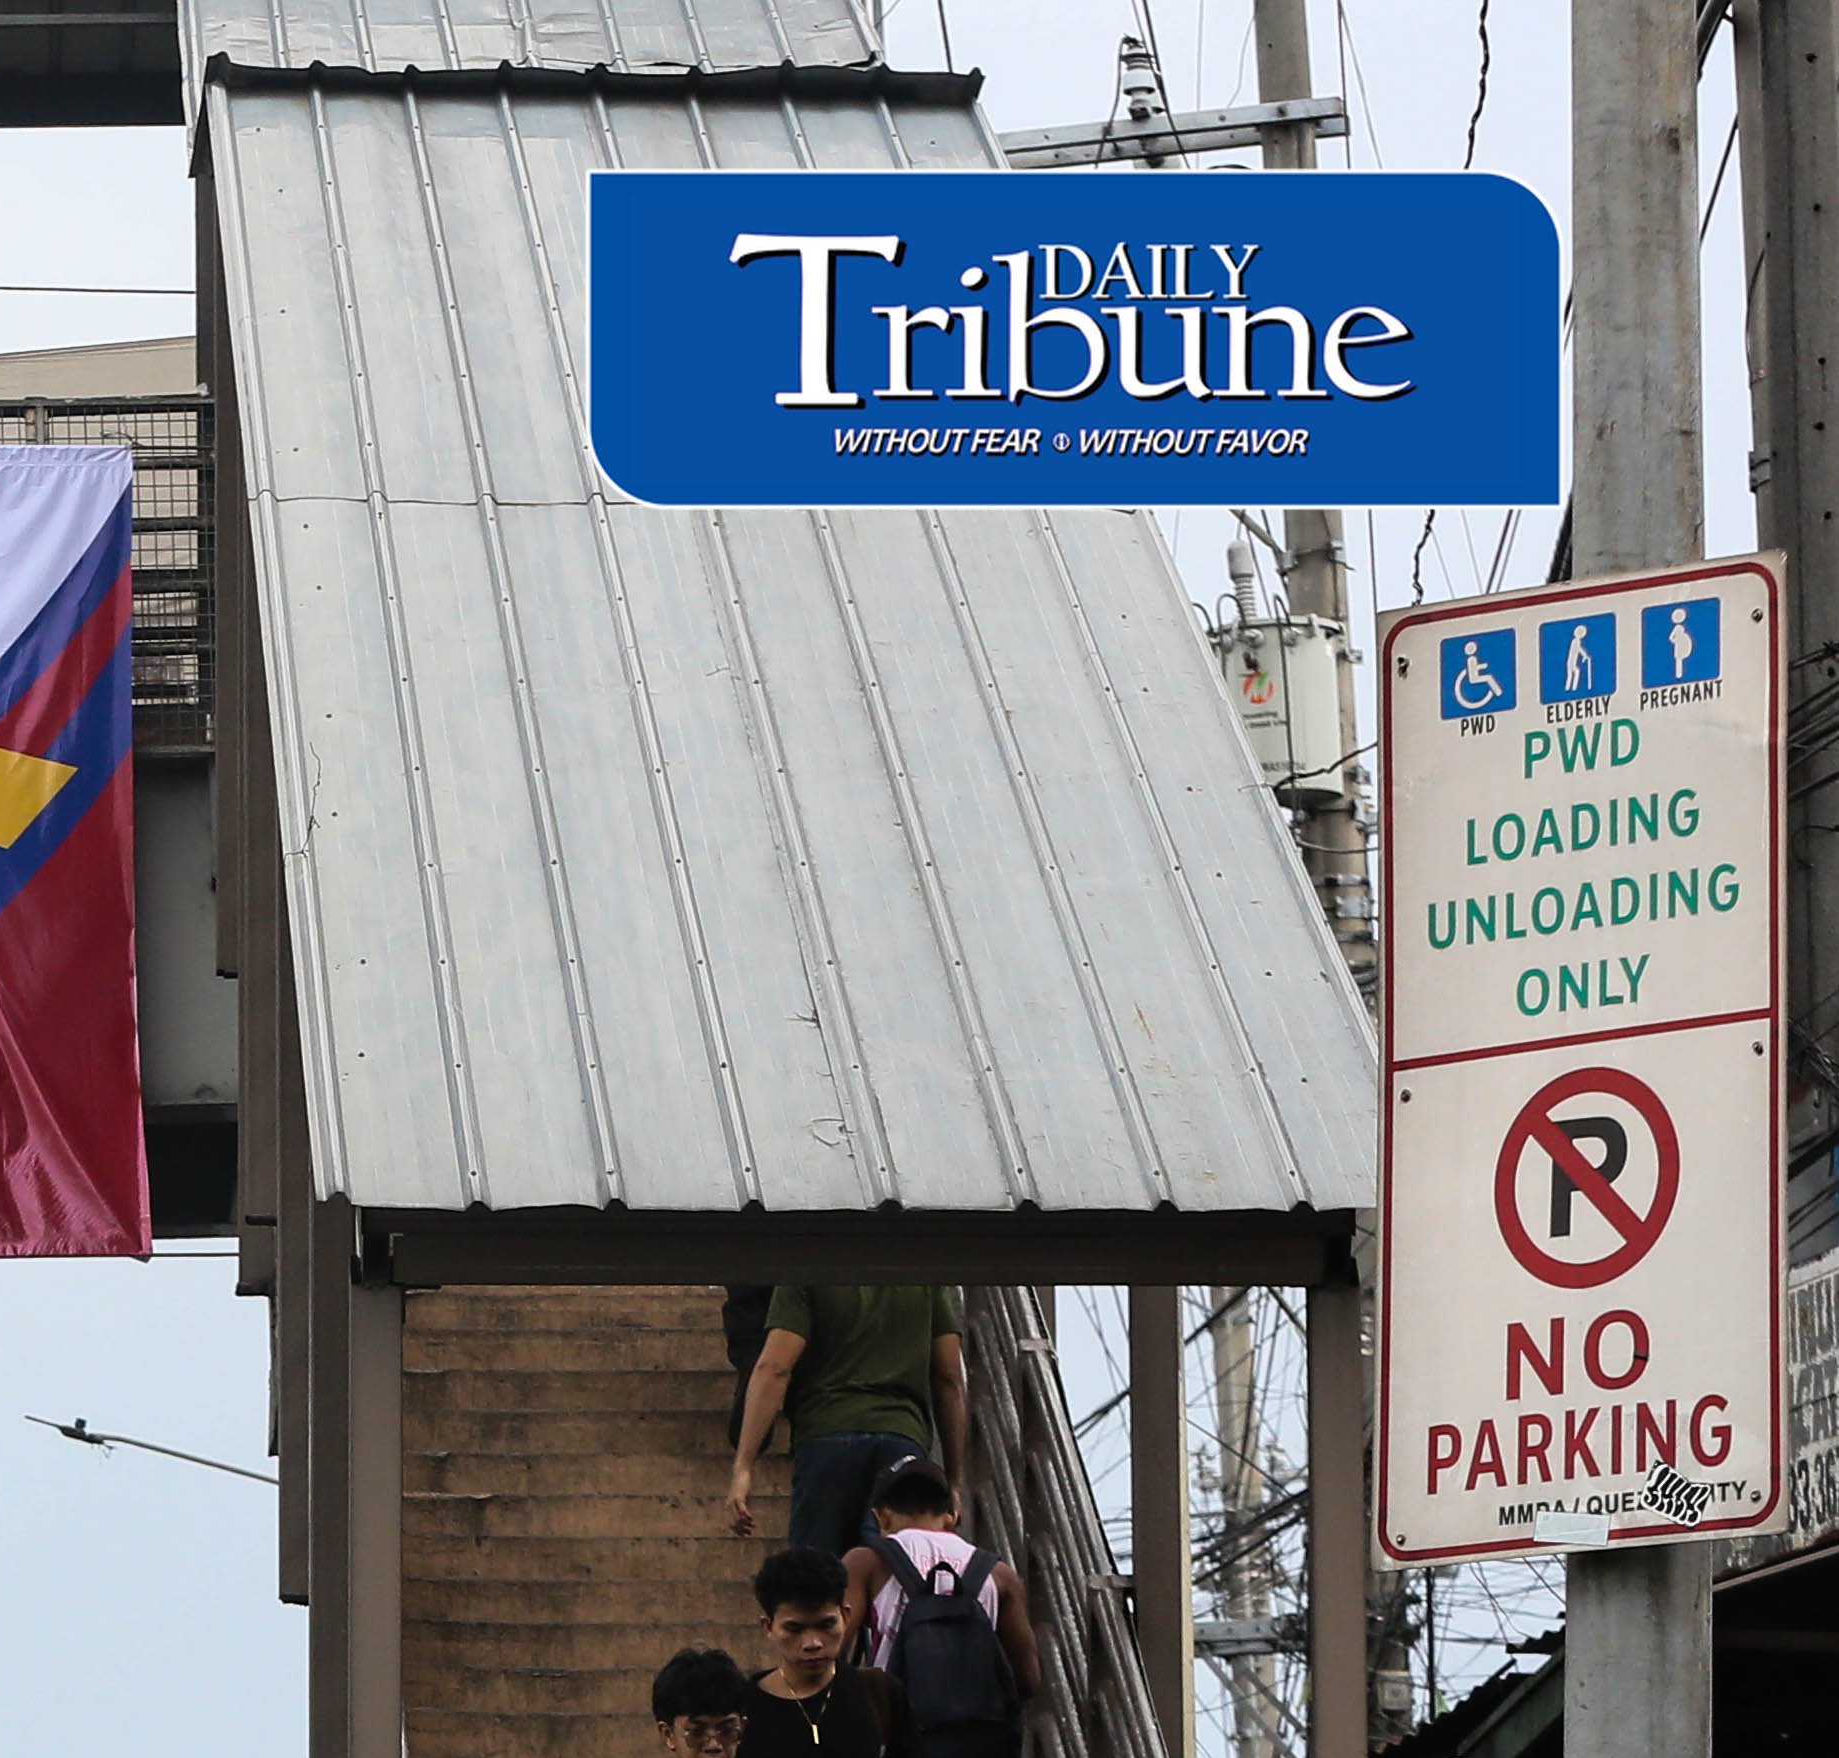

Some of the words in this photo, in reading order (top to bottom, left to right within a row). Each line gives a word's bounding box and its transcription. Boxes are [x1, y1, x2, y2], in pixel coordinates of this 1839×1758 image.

[1460, 713, 1496, 737] PWD
[1546, 696, 1612, 724] ELDERLY
[1640, 679, 1723, 711] PREGNANT
[1523, 717, 1641, 779] PWD
[1466, 788, 1700, 866] LOADING
[1427, 863, 1741, 950] UNLOADING
[1516, 953, 1651, 1016] ONLY
[1504, 1308, 1651, 1401] NO
[1426, 1393, 1733, 1496] PARKING
[1709, 1480, 1748, 1503] ITY
